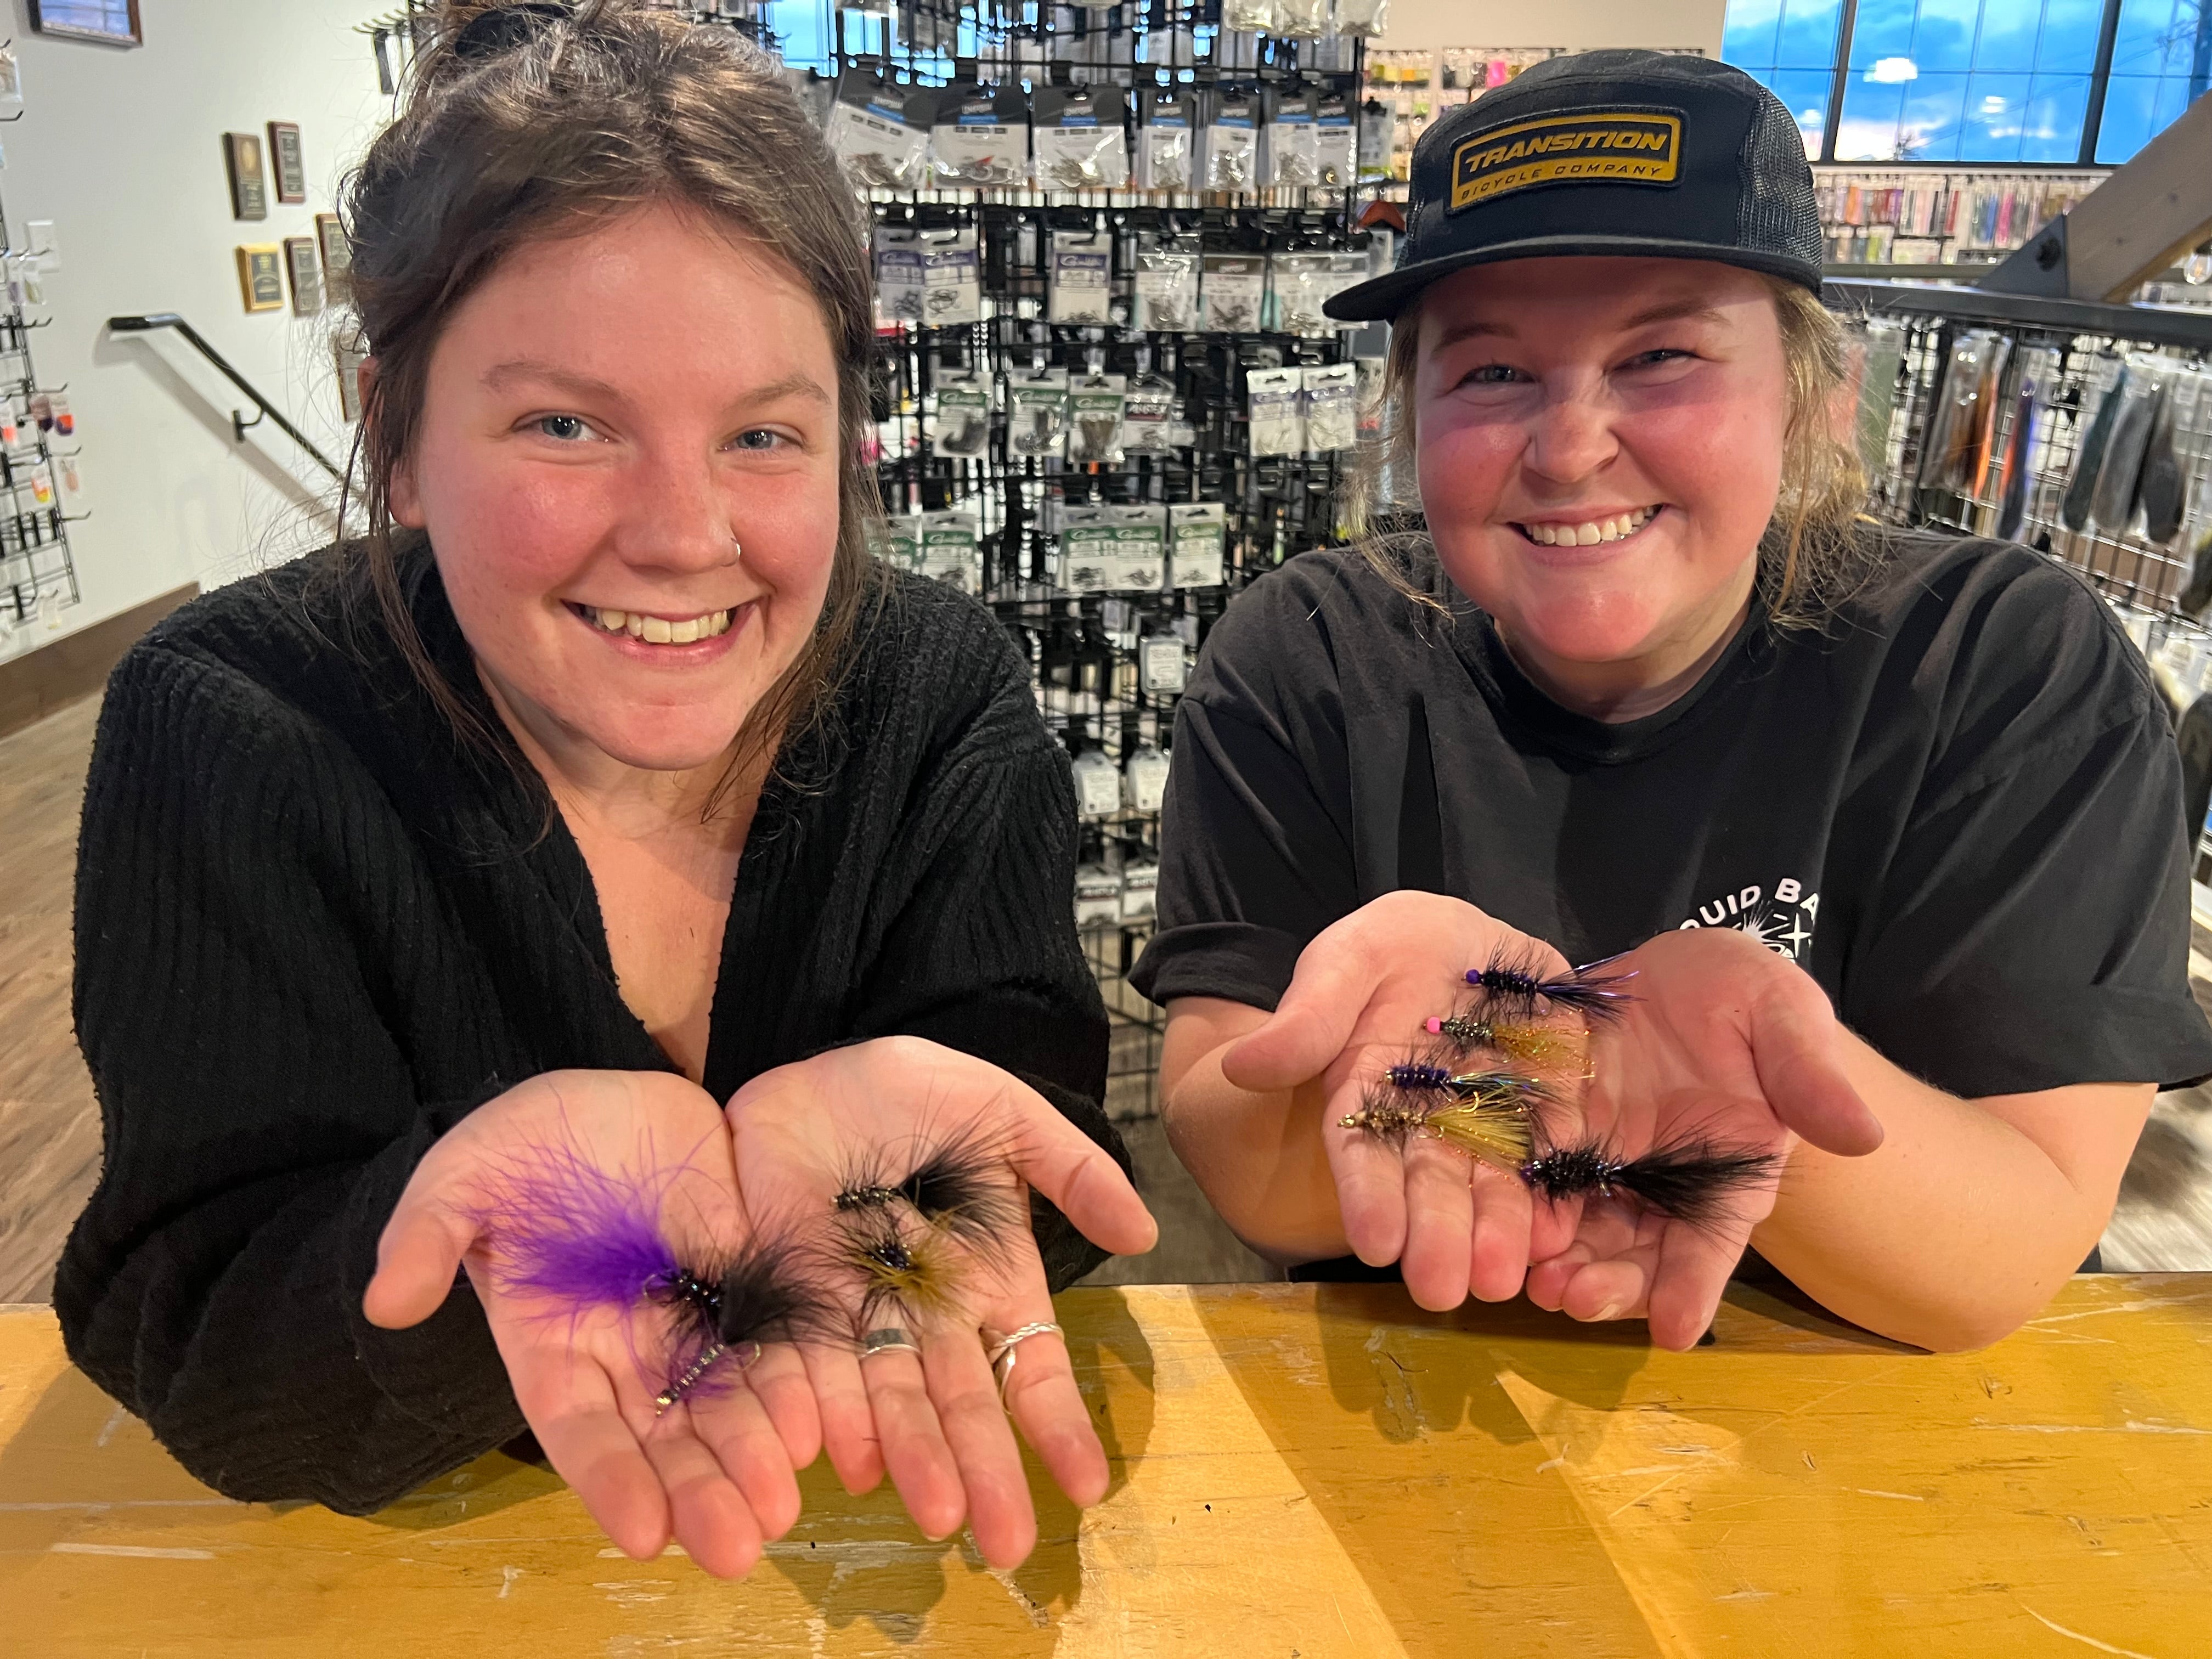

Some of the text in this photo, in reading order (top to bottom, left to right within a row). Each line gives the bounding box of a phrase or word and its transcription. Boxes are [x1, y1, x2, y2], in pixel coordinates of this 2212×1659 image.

[1465, 131, 1668, 173] TRANSITION
[1462, 163, 1662, 200] BICYCLE COMPANY
